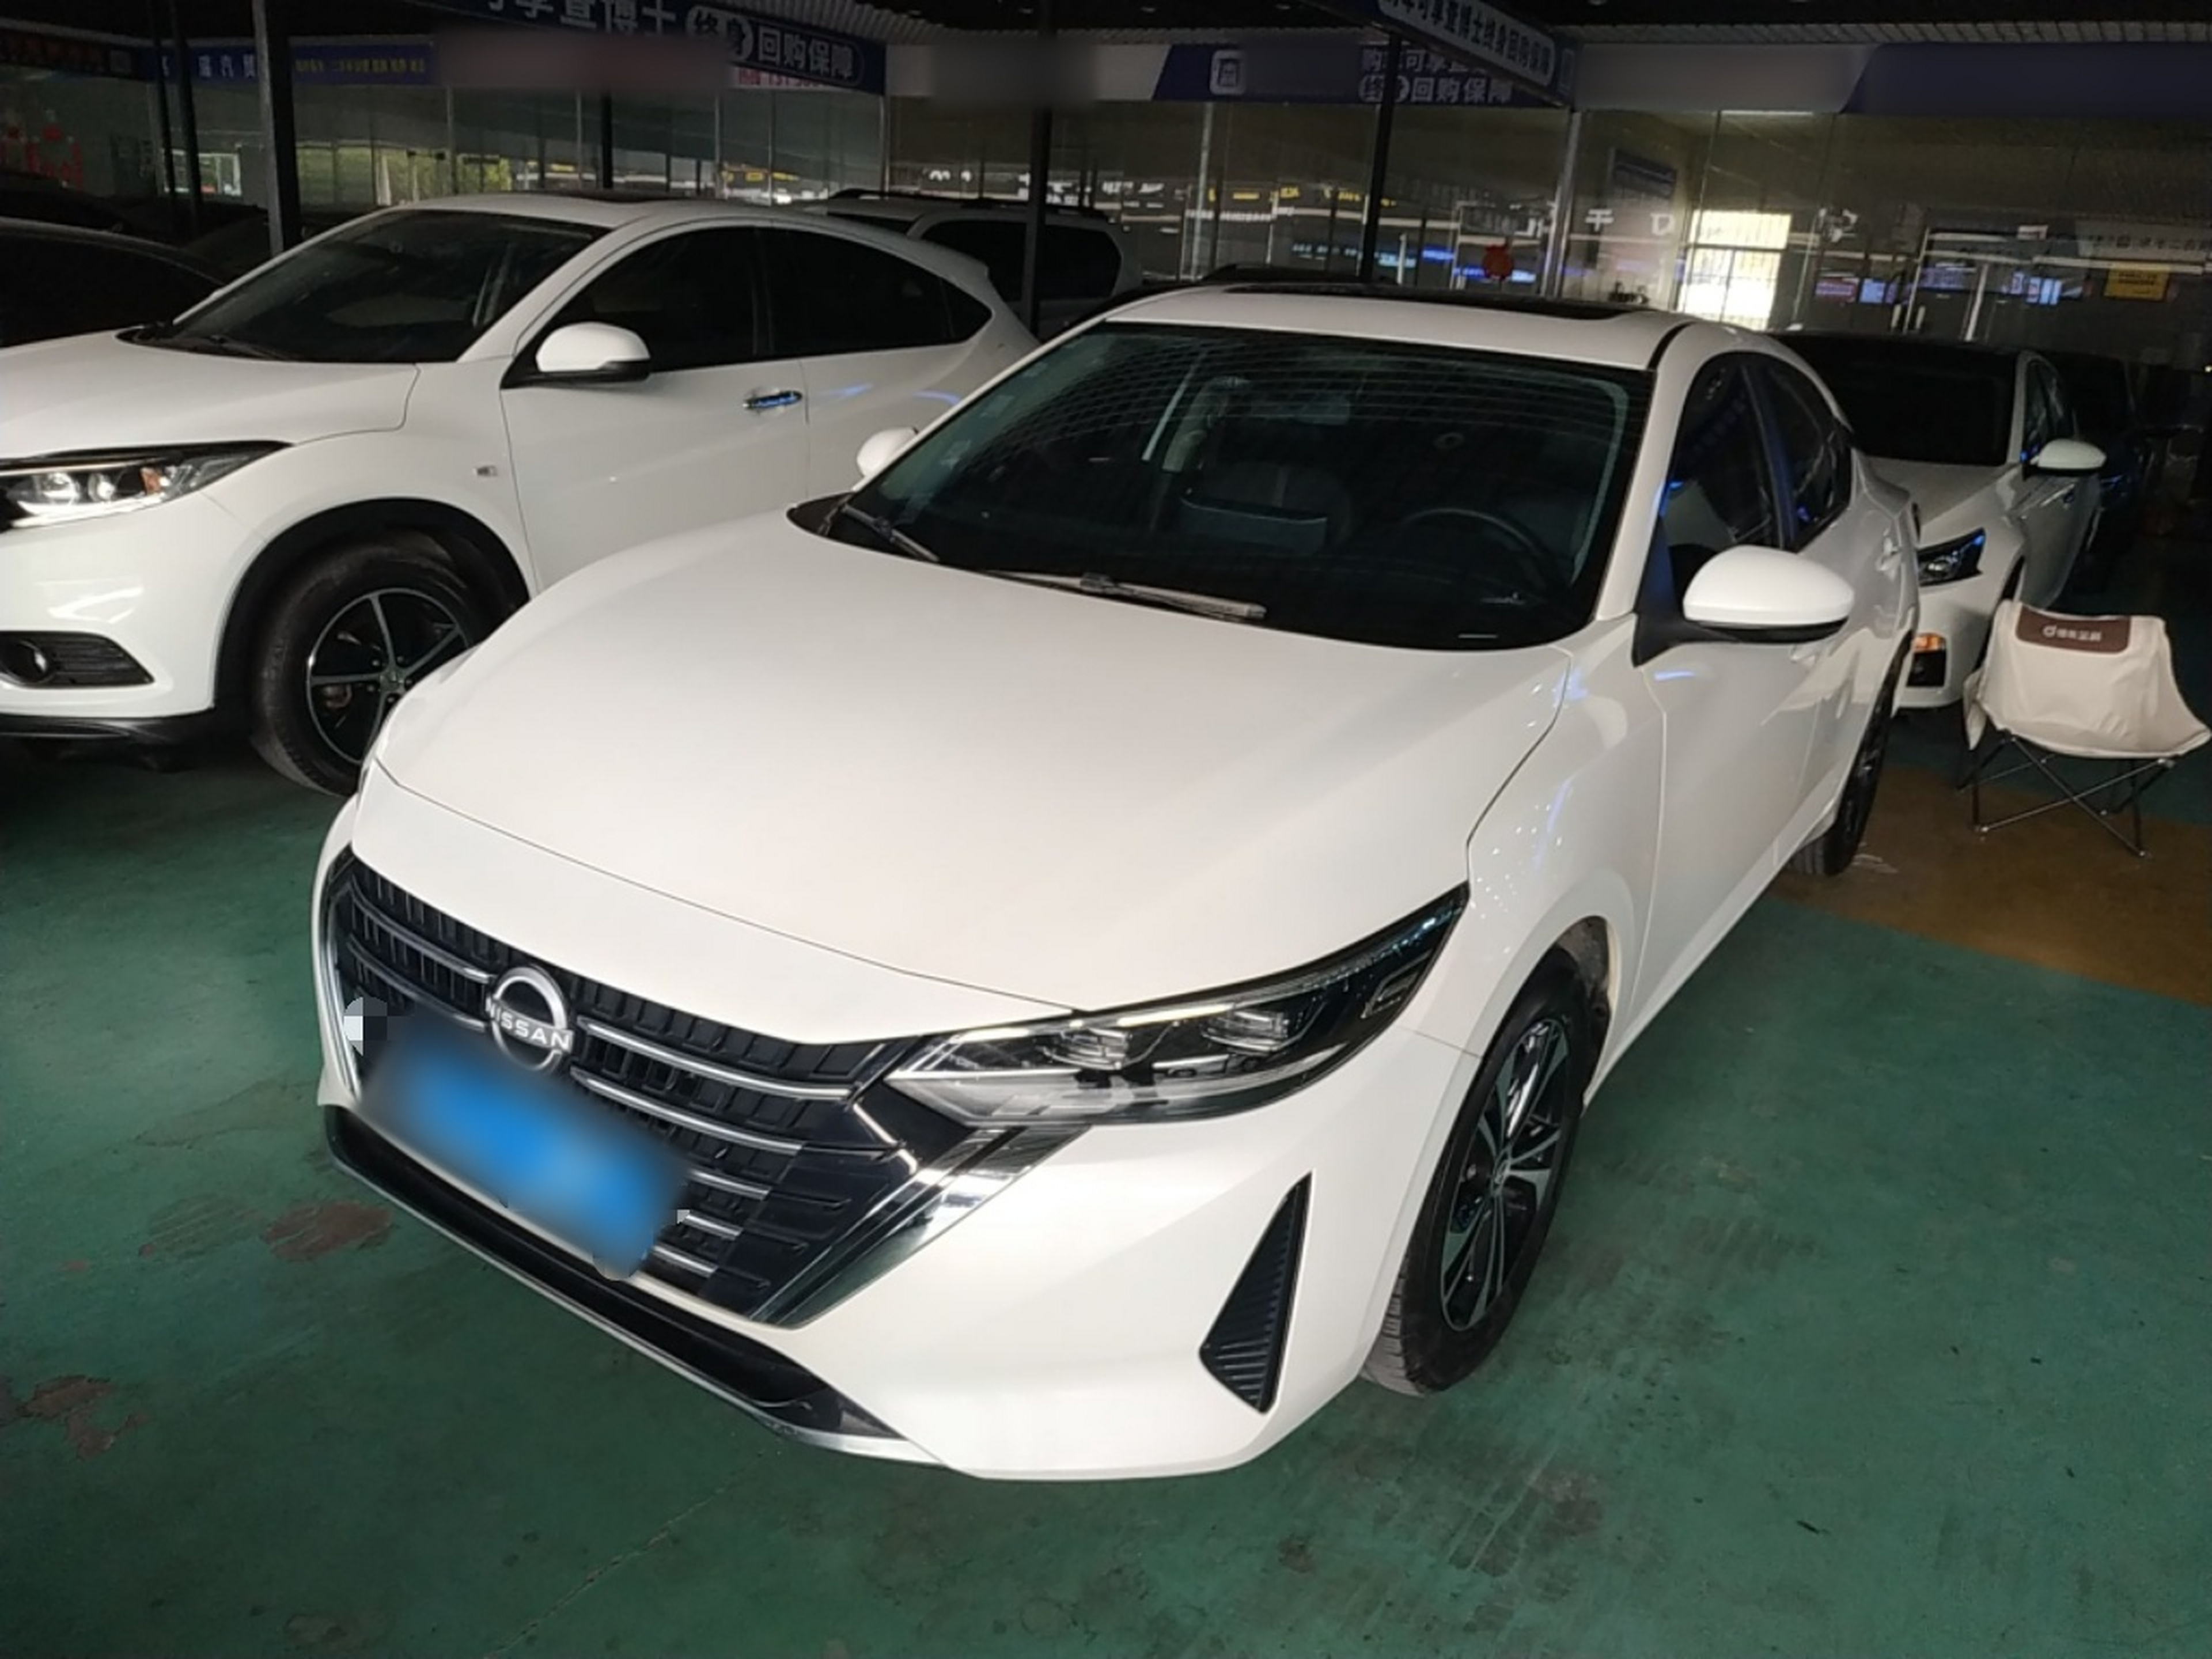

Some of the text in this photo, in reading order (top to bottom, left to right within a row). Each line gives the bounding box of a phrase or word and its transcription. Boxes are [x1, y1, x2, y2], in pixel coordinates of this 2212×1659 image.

[1361, 75, 1513, 103] 终回购保障
[485, 996, 570, 1051] NISSAN
